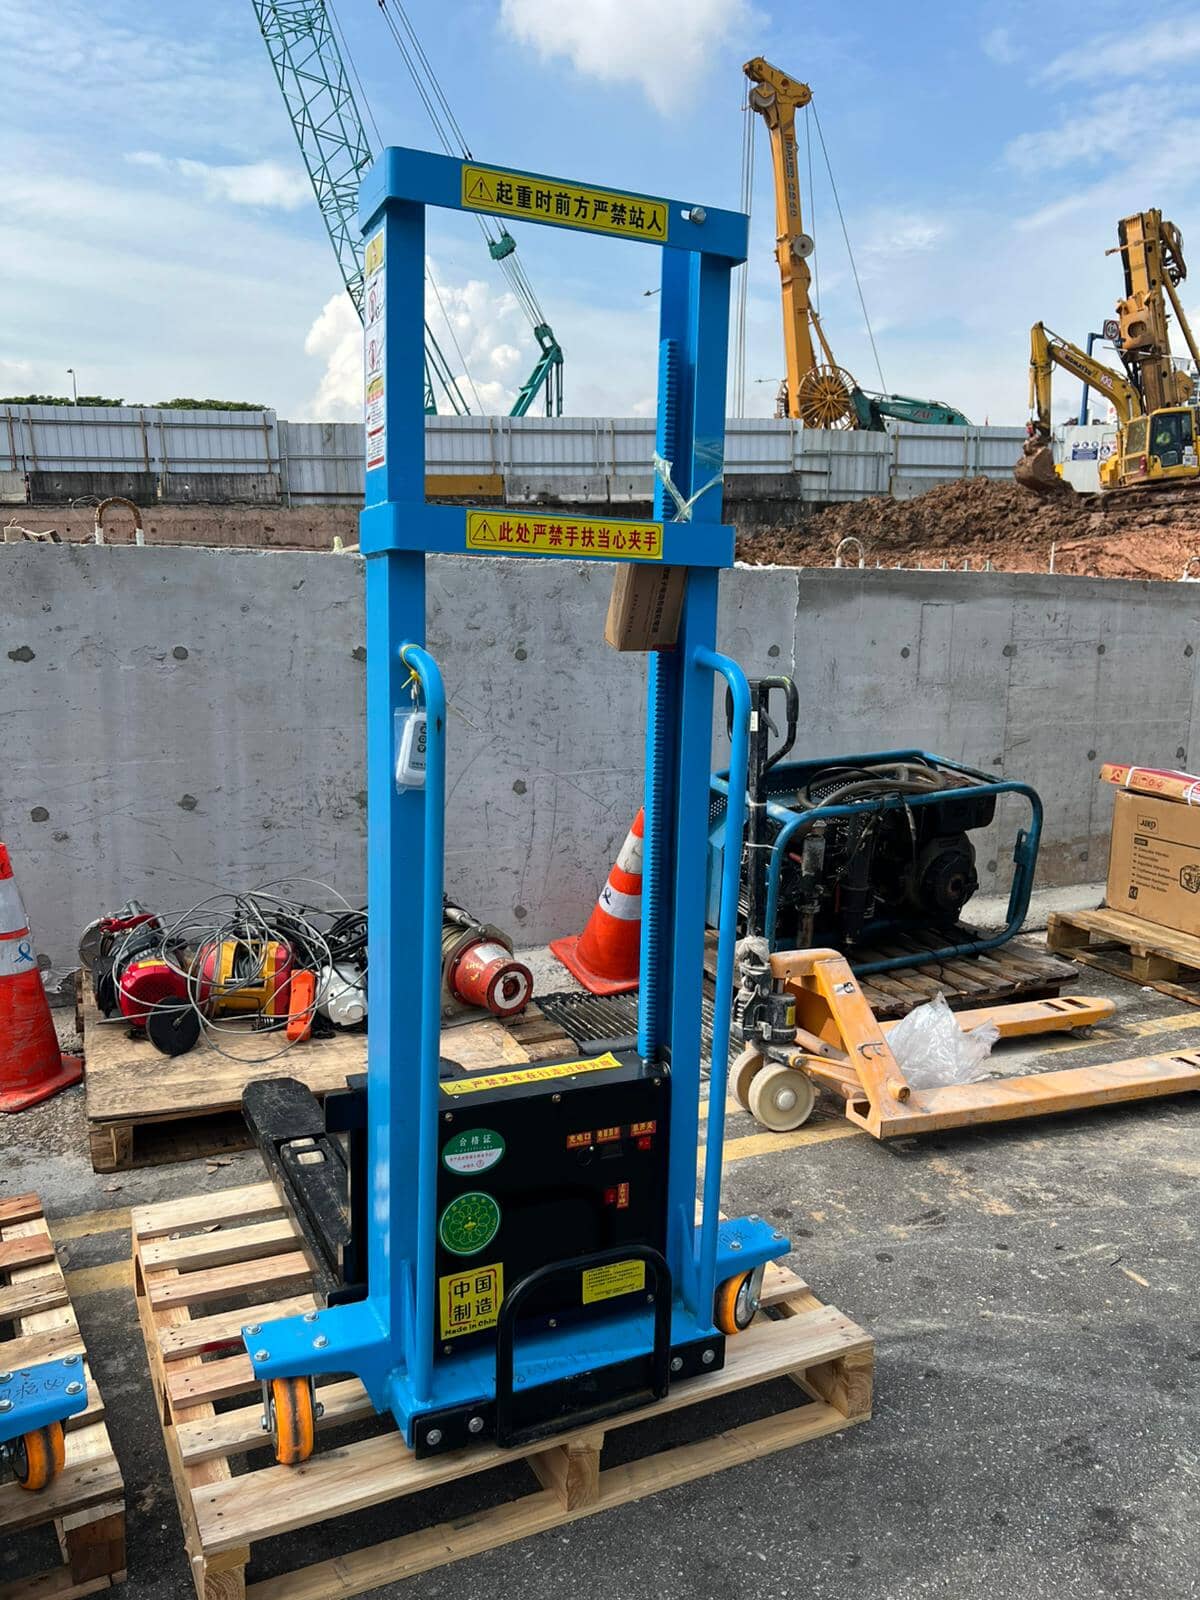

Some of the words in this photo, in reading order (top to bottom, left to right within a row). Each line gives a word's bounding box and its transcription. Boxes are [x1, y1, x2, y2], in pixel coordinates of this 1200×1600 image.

[496, 180, 662, 232] 起重时前方严禁站人
[498, 521, 657, 551] 此处严禁手扶当心夹手
[459, 1134, 492, 1147] 合格证
[454, 1275, 491, 1298] 中国
[453, 1297, 492, 1321] 制造
[444, 1326, 467, 1336] Made
[479, 1318, 497, 1327] Chin
